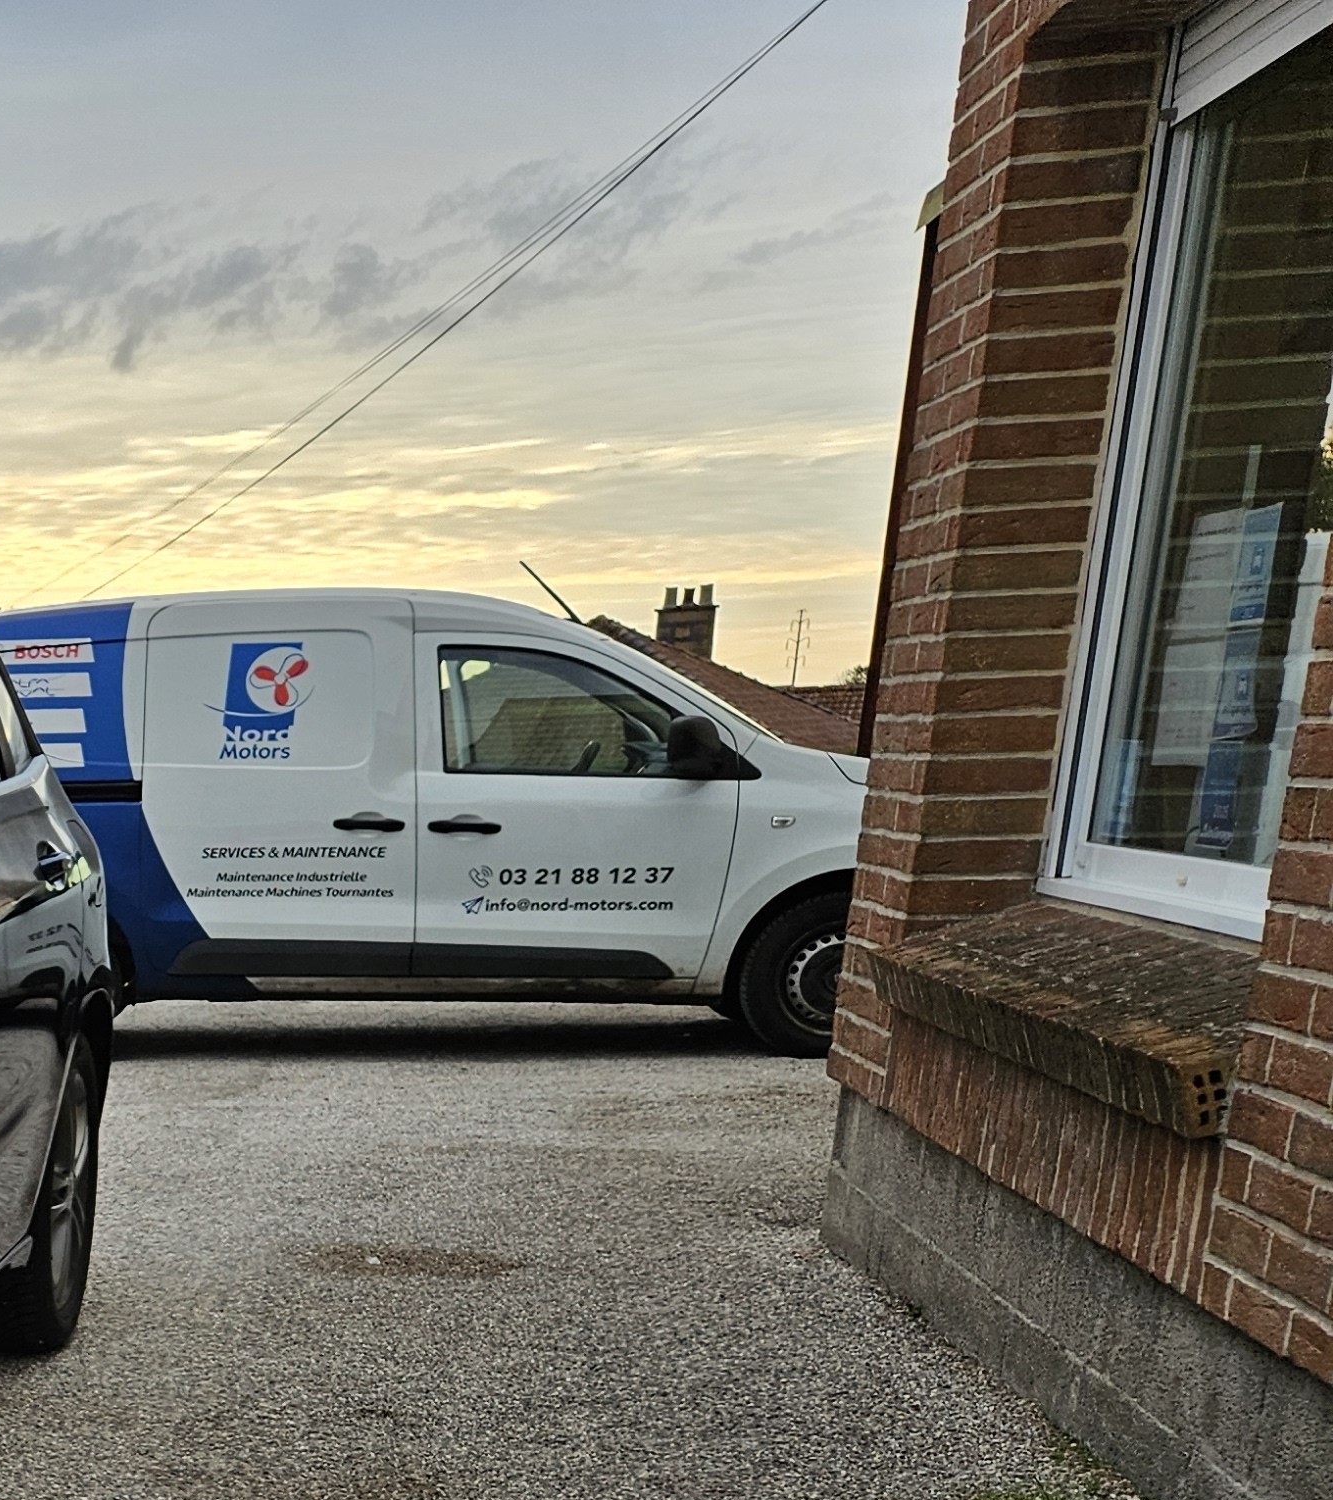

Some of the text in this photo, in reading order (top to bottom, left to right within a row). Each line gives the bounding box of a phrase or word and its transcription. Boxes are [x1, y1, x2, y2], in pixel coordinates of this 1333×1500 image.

[14, 644, 80, 660] BOSCH
[222, 724, 294, 742] Nord
[219, 743, 291, 760] Motors
[201, 846, 387, 859] SERVICES & MAINTENANCE
[216, 871, 367, 883] Maintenance Industrielle
[499, 867, 675, 886] 03 21 88 12 37
[186, 887, 394, 898] Maintenance Machines Tournantes
[485, 897, 674, 912] info@nord-motors.com
